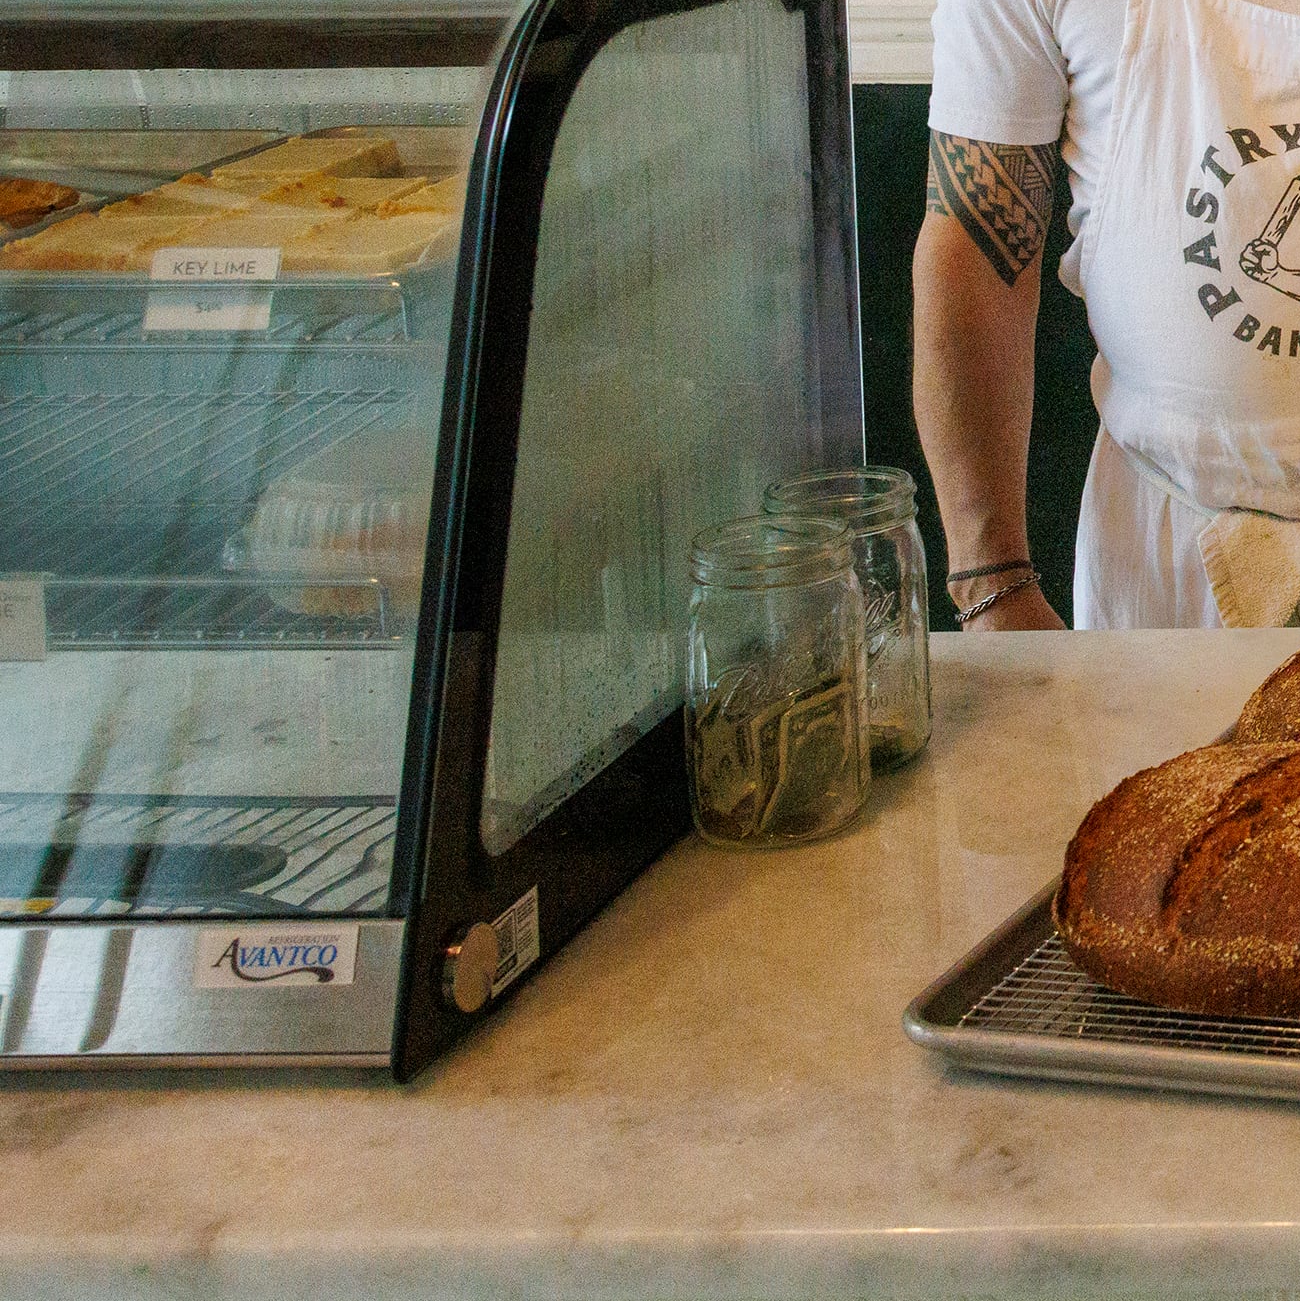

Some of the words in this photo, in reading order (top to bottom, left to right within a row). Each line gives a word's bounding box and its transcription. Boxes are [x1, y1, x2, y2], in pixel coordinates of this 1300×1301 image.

[172, 260, 209, 276] KEY
[212, 260, 257, 276] LIME
[210, 937, 339, 982] AVANTCO
